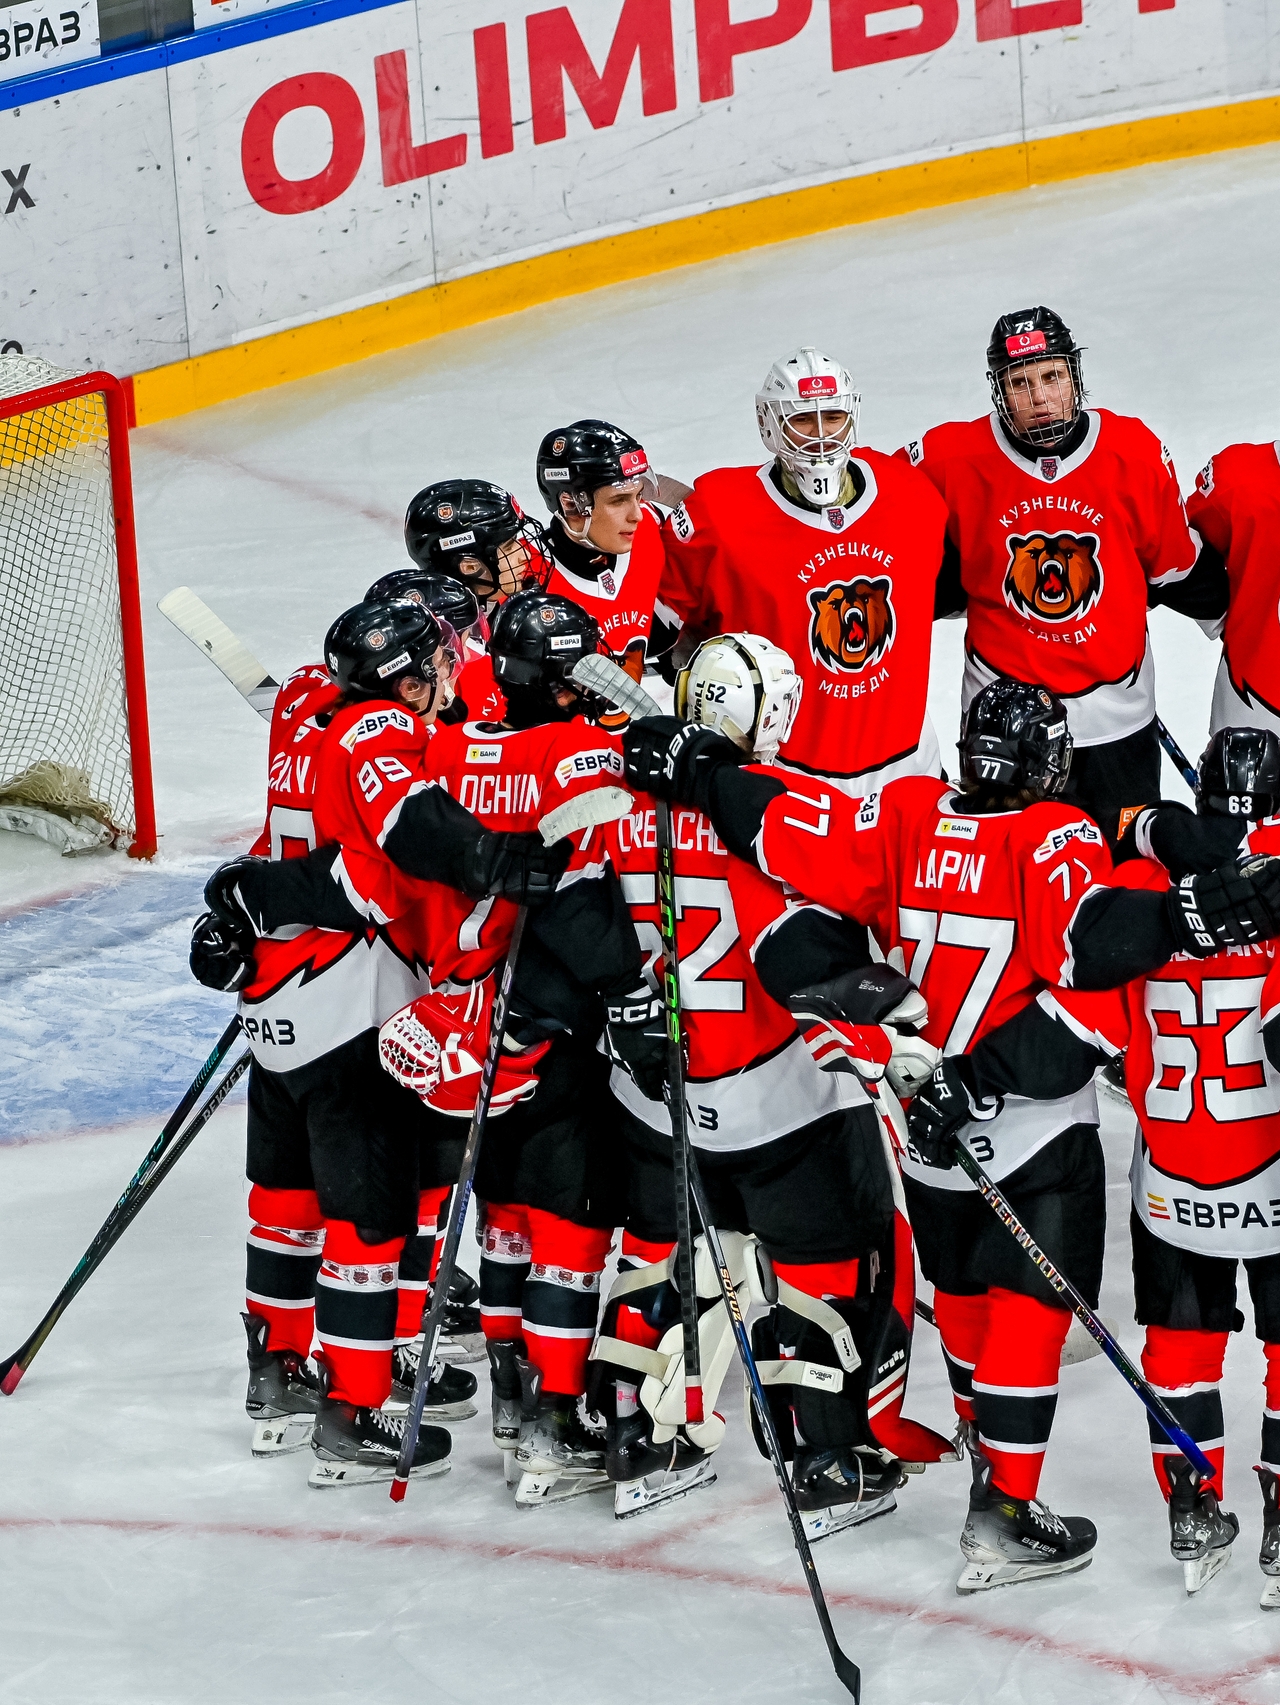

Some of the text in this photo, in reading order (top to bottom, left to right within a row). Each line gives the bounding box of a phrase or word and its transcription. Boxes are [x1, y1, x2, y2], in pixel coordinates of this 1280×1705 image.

[240, 0, 1176, 215] OLIMPB
[1015, 320, 1035, 334] 73
[1010, 342, 1043, 355] OLIMPBET
[801, 387, 835, 395] OLIMPBET
[606, 431, 628, 443] 24
[550, 469, 568, 478] ЕВРАЗ
[813, 478, 829, 495] 31
[999, 495, 1104, 528] КУЗНЕЦКИЕ
[449, 535, 473, 545] ЕВРАЗ
[797, 542, 894, 583] КУЗНЕЦКИЕ
[559, 637, 580, 646] ЕВРАЗ
[387, 653, 409, 671] ЕВРАЗ
[819, 667, 890, 699] МЕДВЕДИ
[705, 683, 727, 704] 52
[981, 760, 1000, 779] 77
[358, 756, 412, 802] 99
[784, 791, 830, 836] 77
[1228, 796, 1252, 813] 63
[951, 825, 972, 833] БАНК
[898, 907, 1015, 1057] 77
[974, 1176, 1067, 1292] SHERWOOD
[719, 1267, 742, 1322] SOYUZ
[809, 1369, 832, 1379] CYBER
